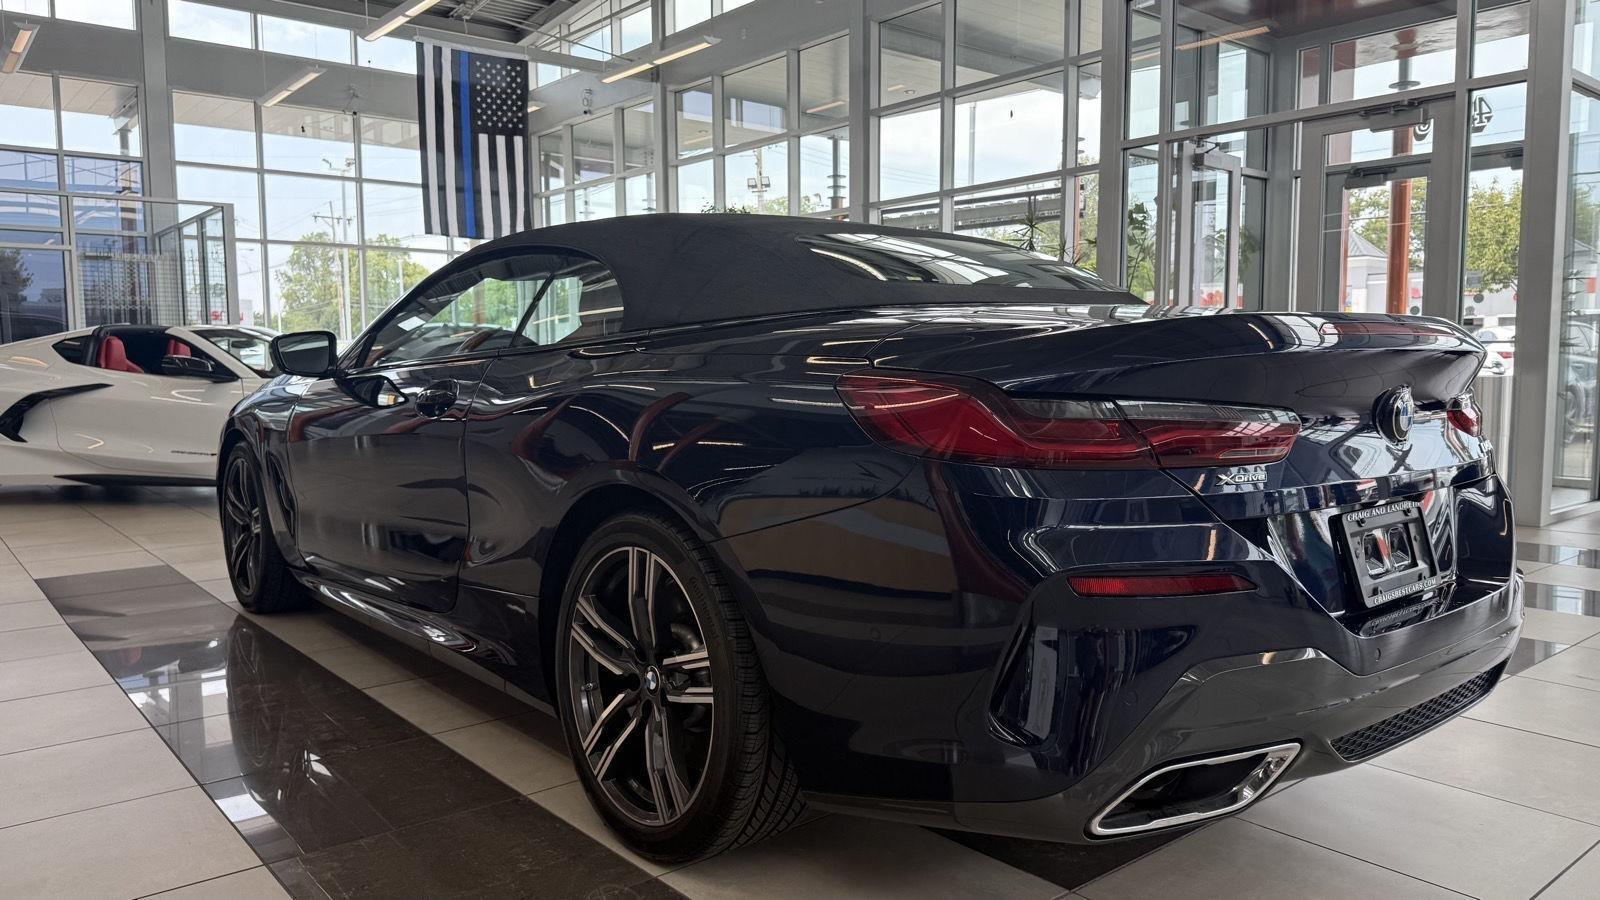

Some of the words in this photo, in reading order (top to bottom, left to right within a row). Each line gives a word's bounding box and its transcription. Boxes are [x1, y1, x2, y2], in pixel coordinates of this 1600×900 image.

[1347, 509, 1371, 522] CRAIG
[1371, 506, 1386, 517] AND
[1374, 577, 1436, 604] CRAIGSBESTCARS.COM
